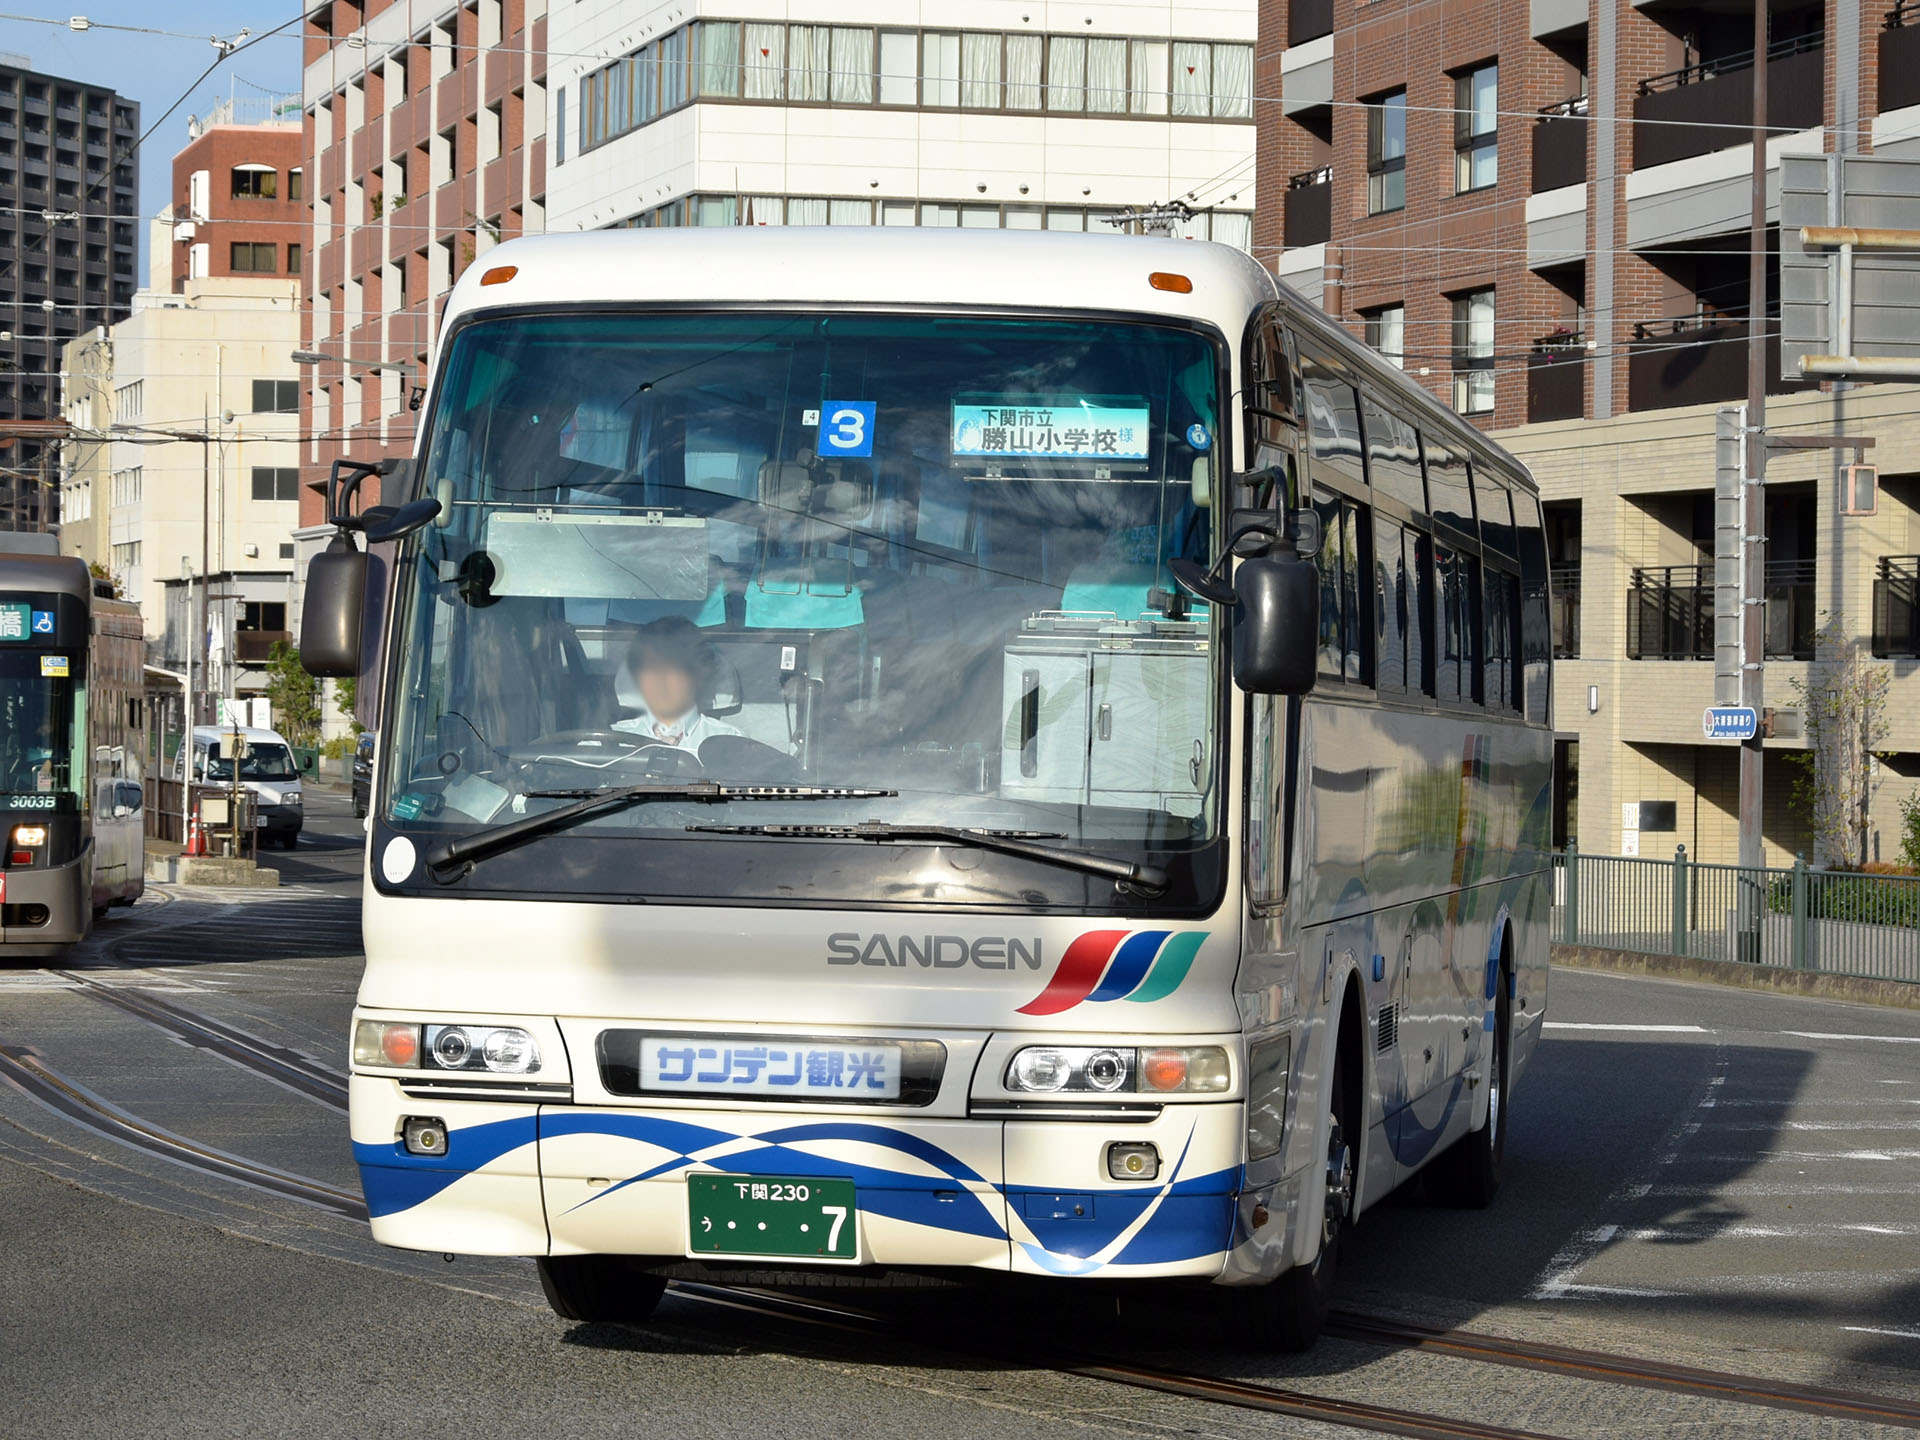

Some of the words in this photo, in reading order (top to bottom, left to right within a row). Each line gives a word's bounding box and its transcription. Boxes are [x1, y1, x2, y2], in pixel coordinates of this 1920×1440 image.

[828, 409, 865, 449] 3
[981, 409, 1054, 428] 下関市立
[9, 795, 56, 809] 3003B
[827, 932, 1042, 971] SANDEN
[657, 1047, 887, 1089] サンデン観光
